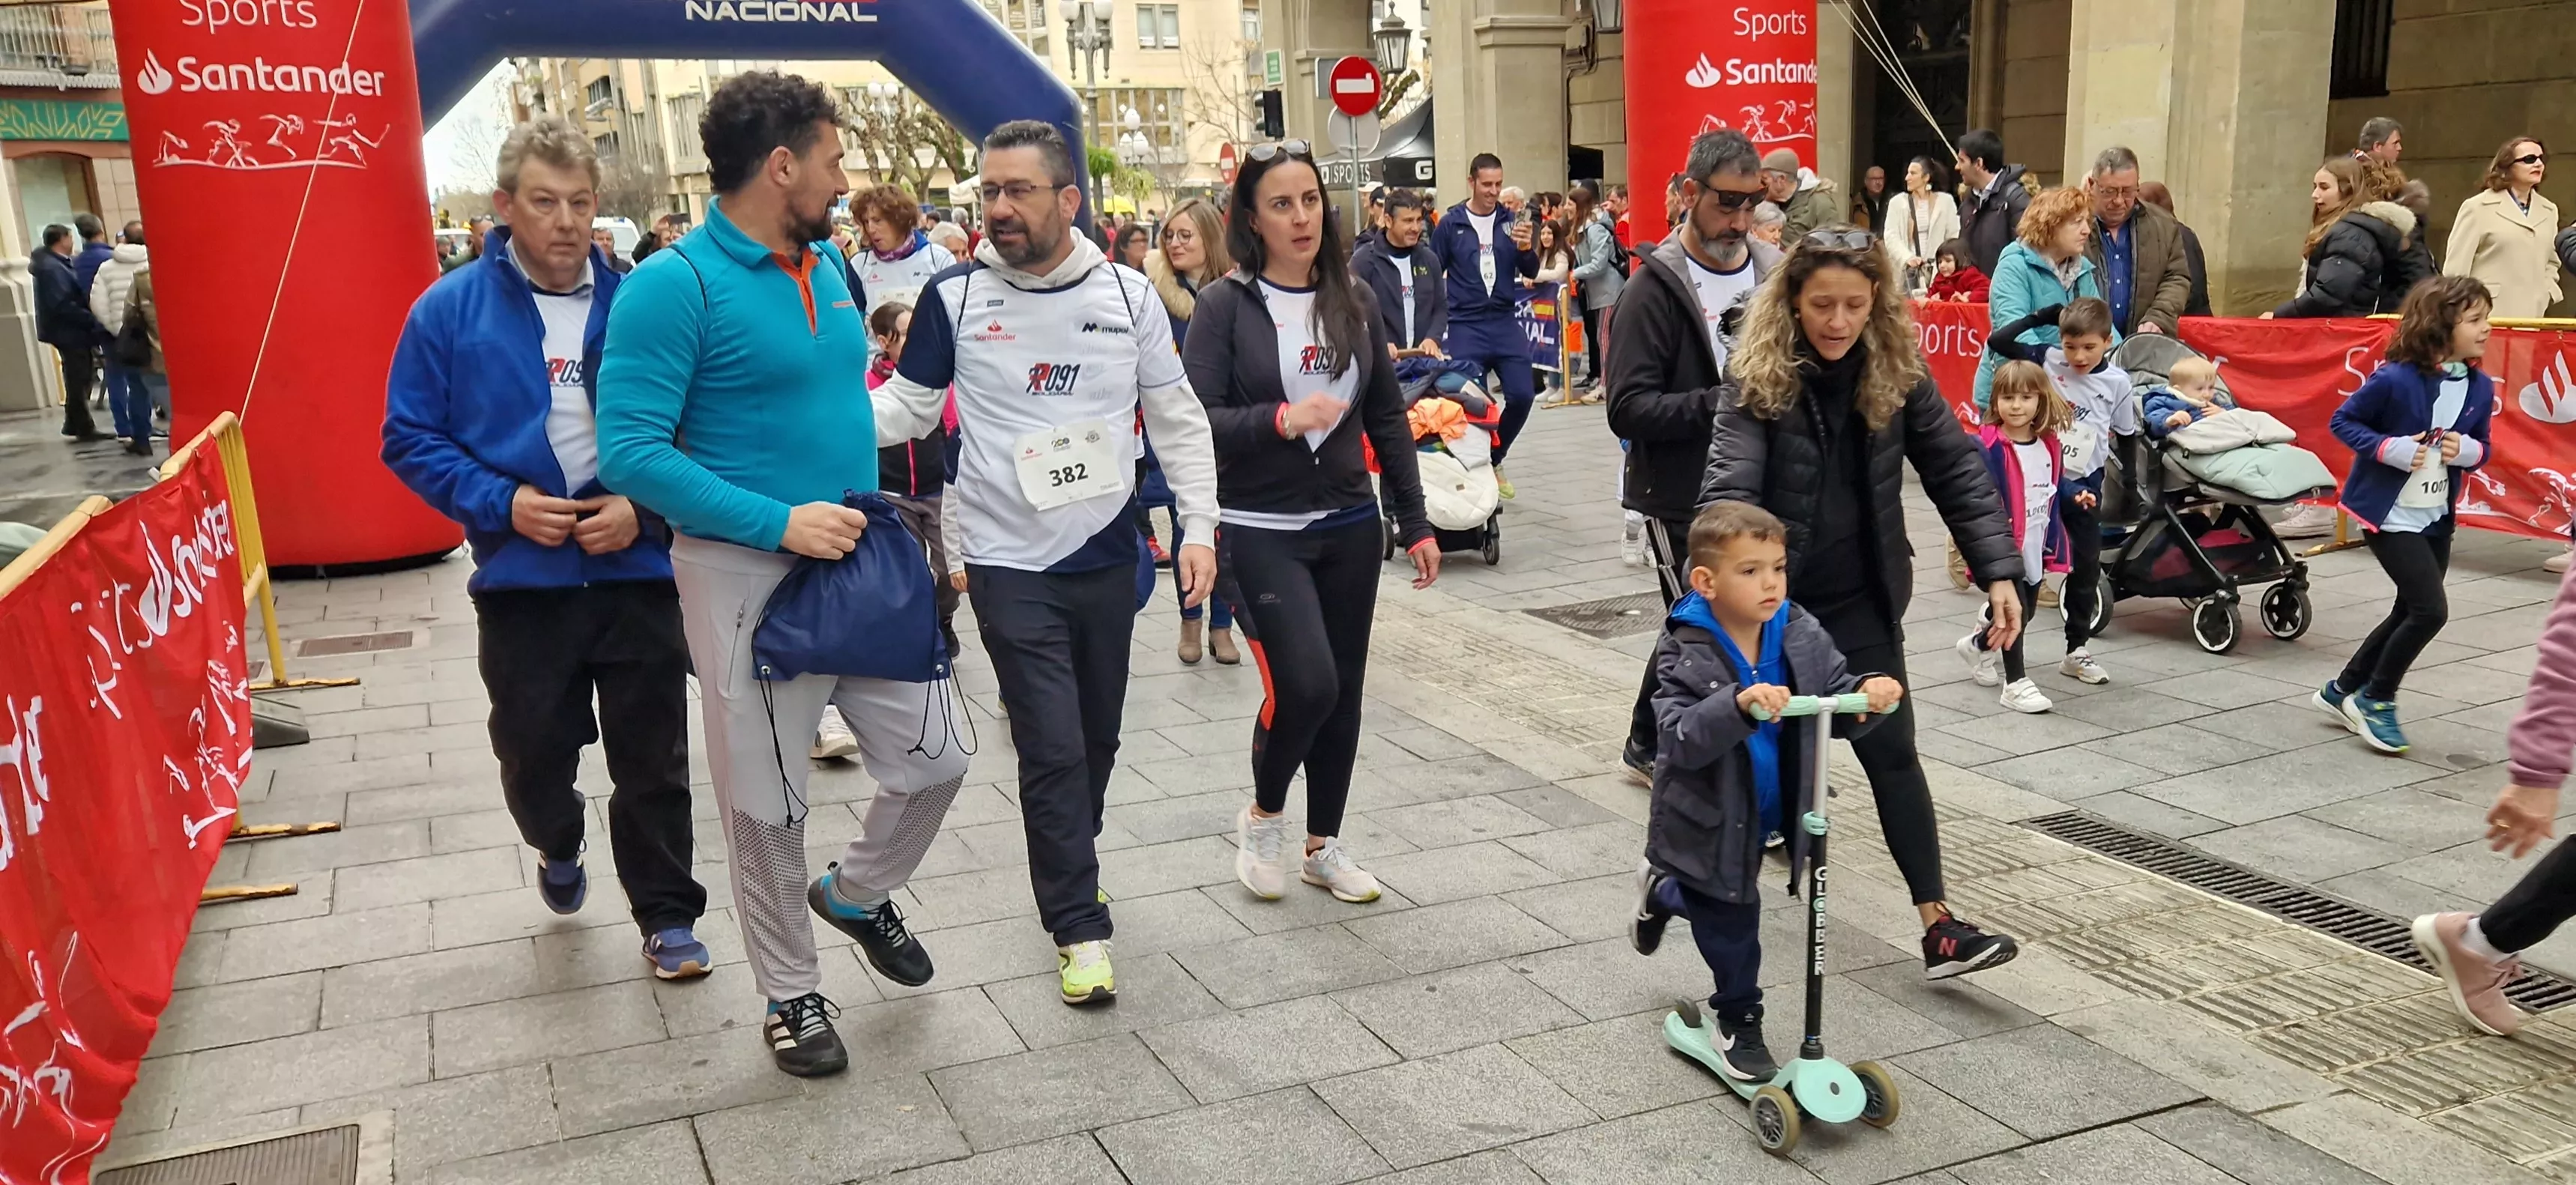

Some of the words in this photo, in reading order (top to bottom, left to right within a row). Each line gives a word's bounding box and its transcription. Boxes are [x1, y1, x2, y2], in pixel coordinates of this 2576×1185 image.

[182, 0, 317, 34] Sports
[685, 0, 877, 22] NACIONAL
[1733, 7, 1806, 42] Sports
[177, 56, 385, 97] Santander
[1048, 463, 1089, 488] 382
[1812, 865, 1828, 976] GLOBBER
